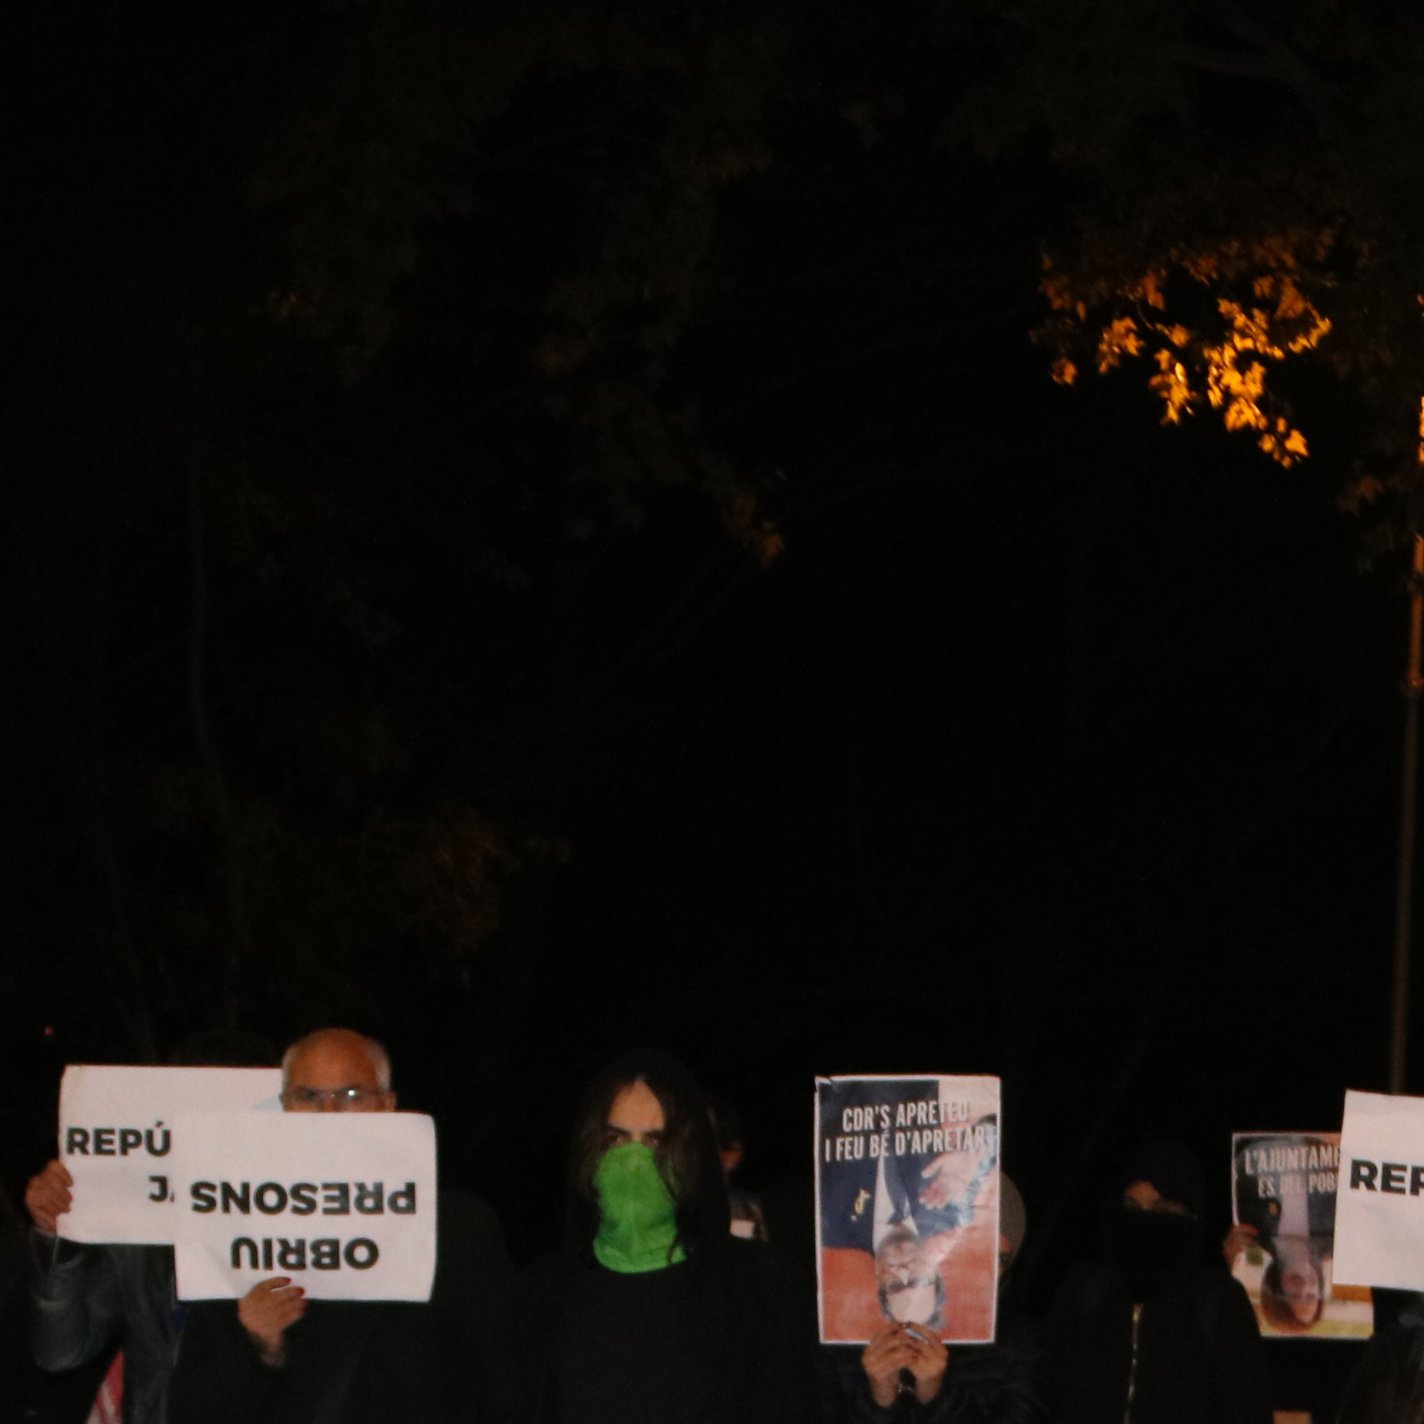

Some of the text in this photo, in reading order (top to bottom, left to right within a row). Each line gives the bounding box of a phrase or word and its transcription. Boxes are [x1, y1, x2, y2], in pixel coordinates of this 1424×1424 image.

[842, 1100, 971, 1132] CDR'S APRETEU
[825, 1125, 988, 1163] I FEU BÉ D'APRETAR
[189, 1180, 418, 1216] PRESONS
[231, 1236, 380, 1271] OBRIU
